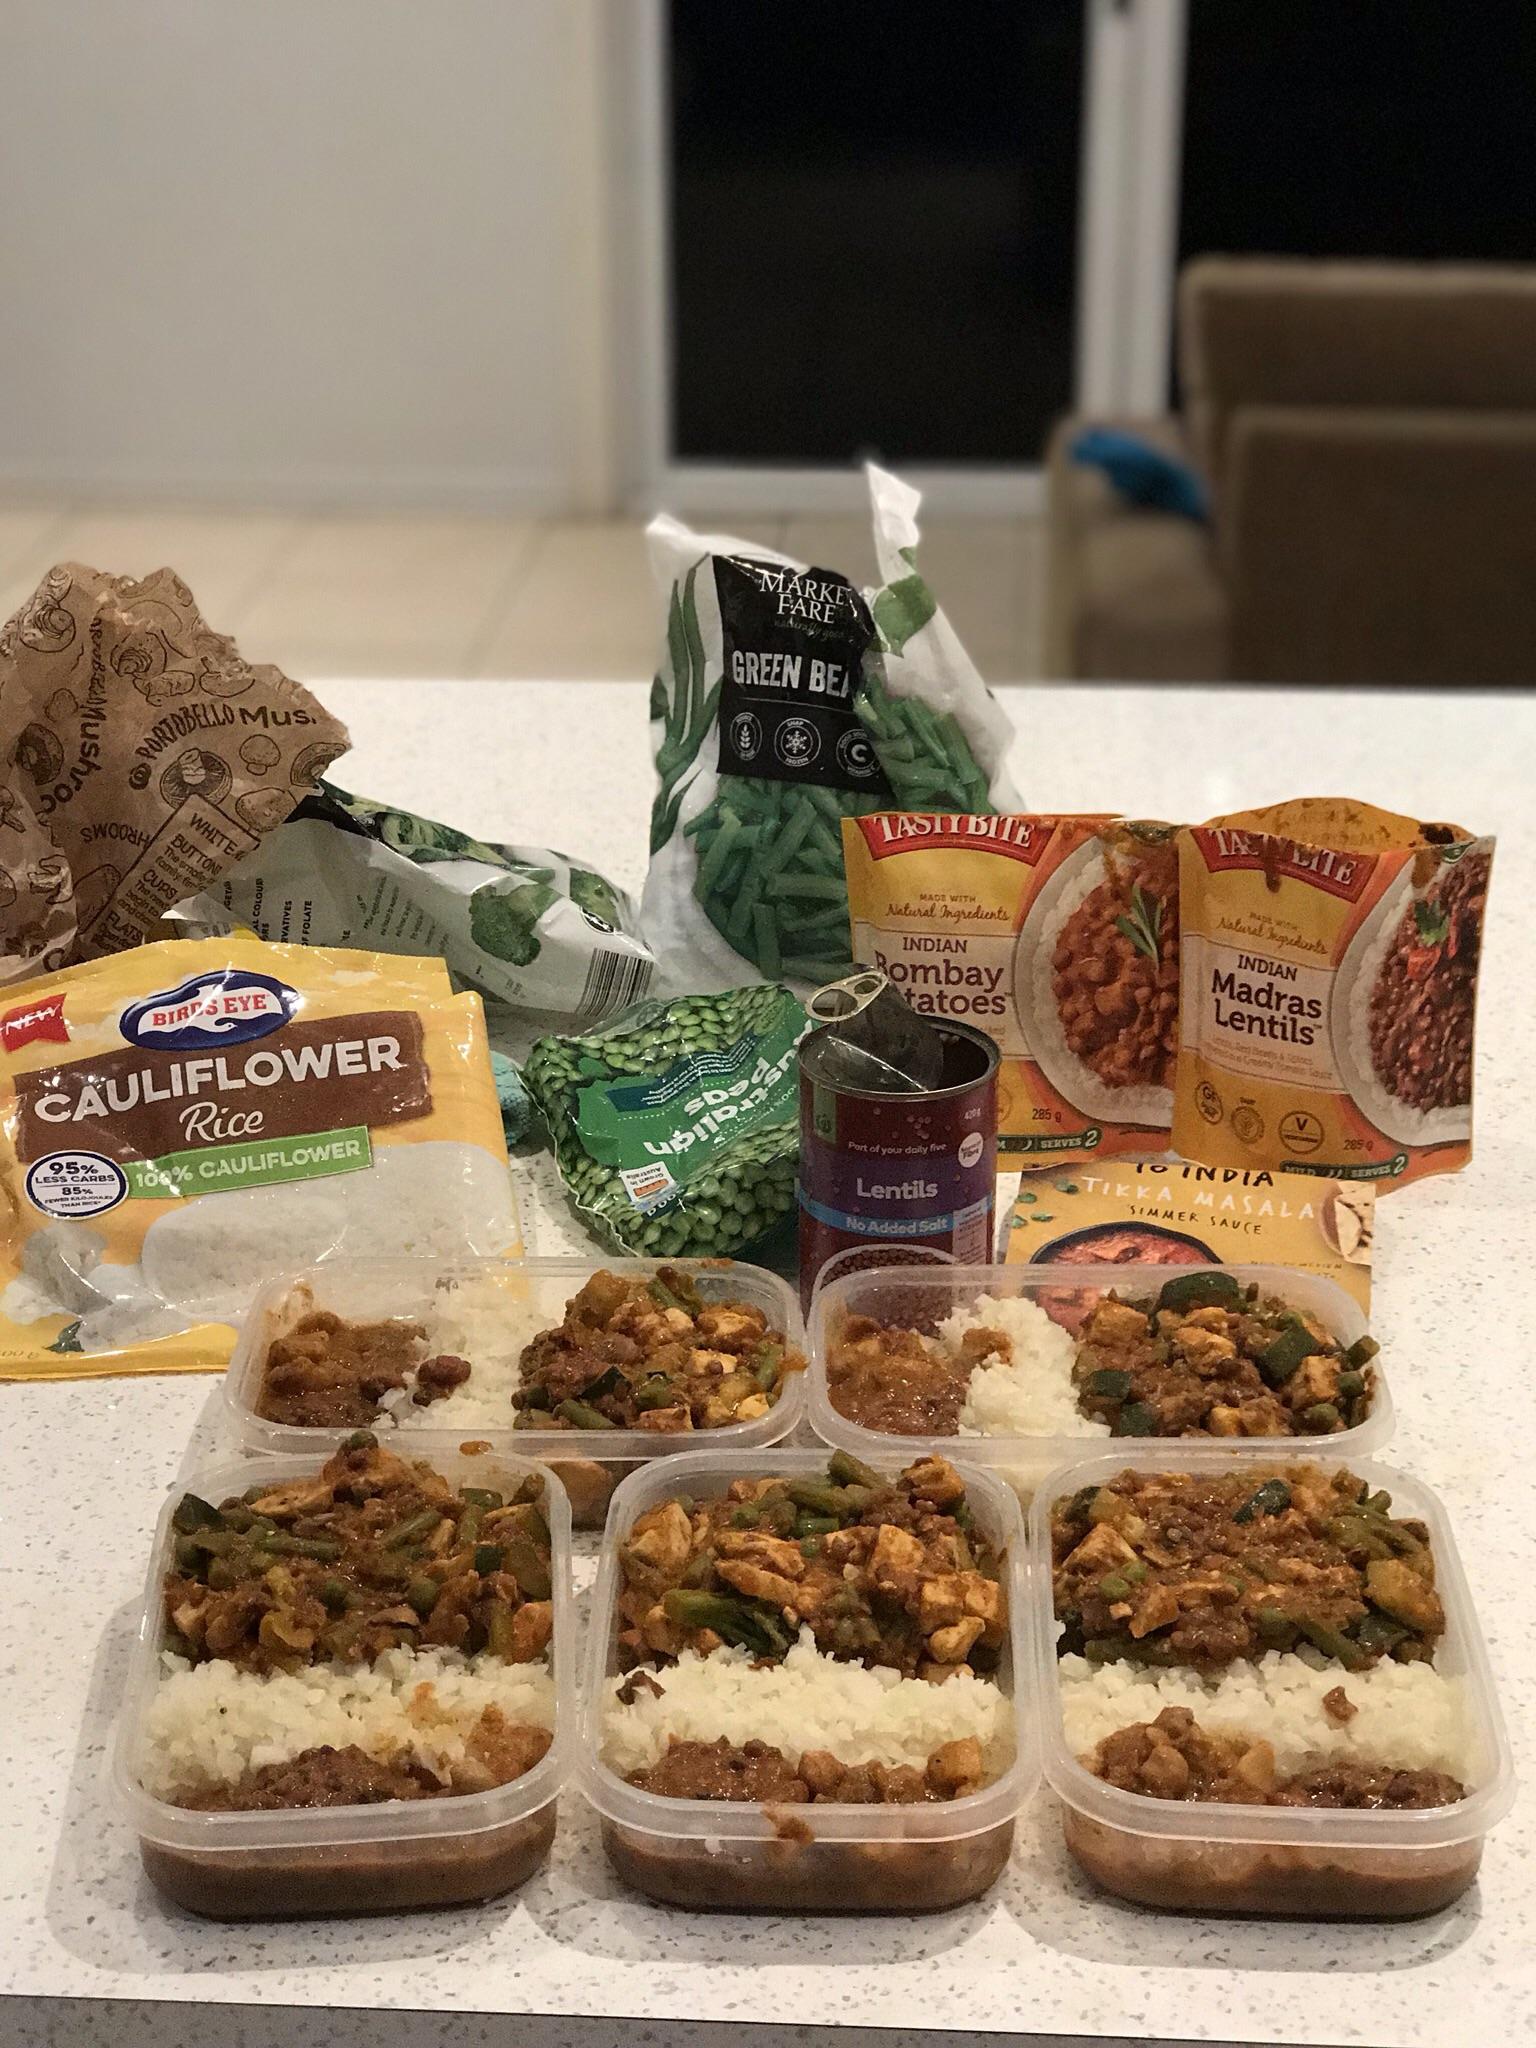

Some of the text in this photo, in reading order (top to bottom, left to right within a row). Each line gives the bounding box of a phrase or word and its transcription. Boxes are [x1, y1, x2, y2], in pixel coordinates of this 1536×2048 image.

[760, 573, 852, 606] MARKE
[777, 594, 836, 624] FARE
[732, 650, 802, 689] GREEN
[135, 703, 235, 760] PORTOBELLO
[189, 812, 238, 857] WHITE
[142, 868, 178, 900] CUPS
[106, 909, 145, 943] FLATS
[302, 900, 313, 936] FOLATE
[884, 903, 1010, 925] Natural Ingredients
[902, 936, 968, 954] INDIAN
[1215, 915, 1329, 955] Natural Ingredients
[874, 949, 1005, 993] Bombay
[1237, 954, 1299, 982] INDIAN
[152, 993, 268, 1027] BIRDS EYE
[1210, 968, 1323, 1020] Madras
[1214, 999, 1316, 1046] Lentils
[34, 1035, 402, 1124] CAULIFLOWER
[684, 1056, 771, 1117] peas
[178, 1100, 266, 1143] Rice
[1295, 1117, 1308, 1131] V
[848, 1140, 868, 1151] Part
[904, 1144, 929, 1155] daily
[1040, 1129, 1099, 1150] SERVES 2
[35, 1174, 116, 1184] LESS CARBS
[49, 1161, 99, 1175] 95%
[135, 1139, 362, 1189] 100% CAULIFLOWER
[624, 1165, 662, 1182] Australia
[638, 1171, 664, 1184] Grown
[1181, 1166, 1274, 1188] INDIA
[1350, 1165, 1391, 1178] SERVES
[1393, 1156, 1406, 1174] 2
[61, 1186, 94, 1196] 85%
[856, 1177, 939, 1200] Lentils
[1080, 1175, 1316, 1221] TIKKA MASALA
[846, 1216, 948, 1235] No Added Salt
[1128, 1204, 1263, 1236] SIMMER SAUCE
